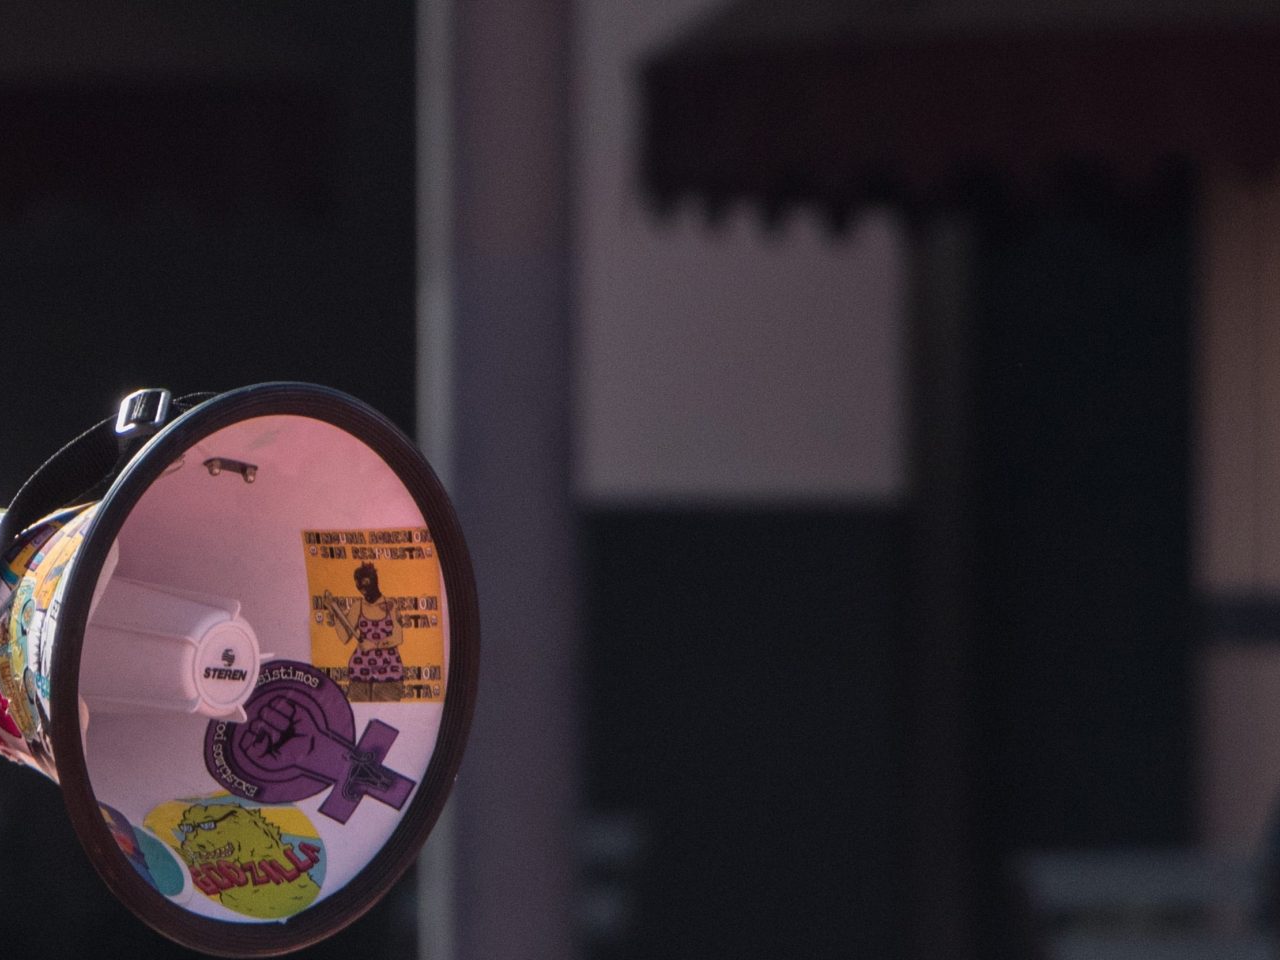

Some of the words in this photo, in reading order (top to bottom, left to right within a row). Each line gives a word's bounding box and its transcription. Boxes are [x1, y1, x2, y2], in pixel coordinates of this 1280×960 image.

[321, 547, 347, 559] SIN
[203, 667, 248, 682] STEREN
[256, 666, 320, 689] sistimos
[187, 841, 320, 896] GODZILLA
